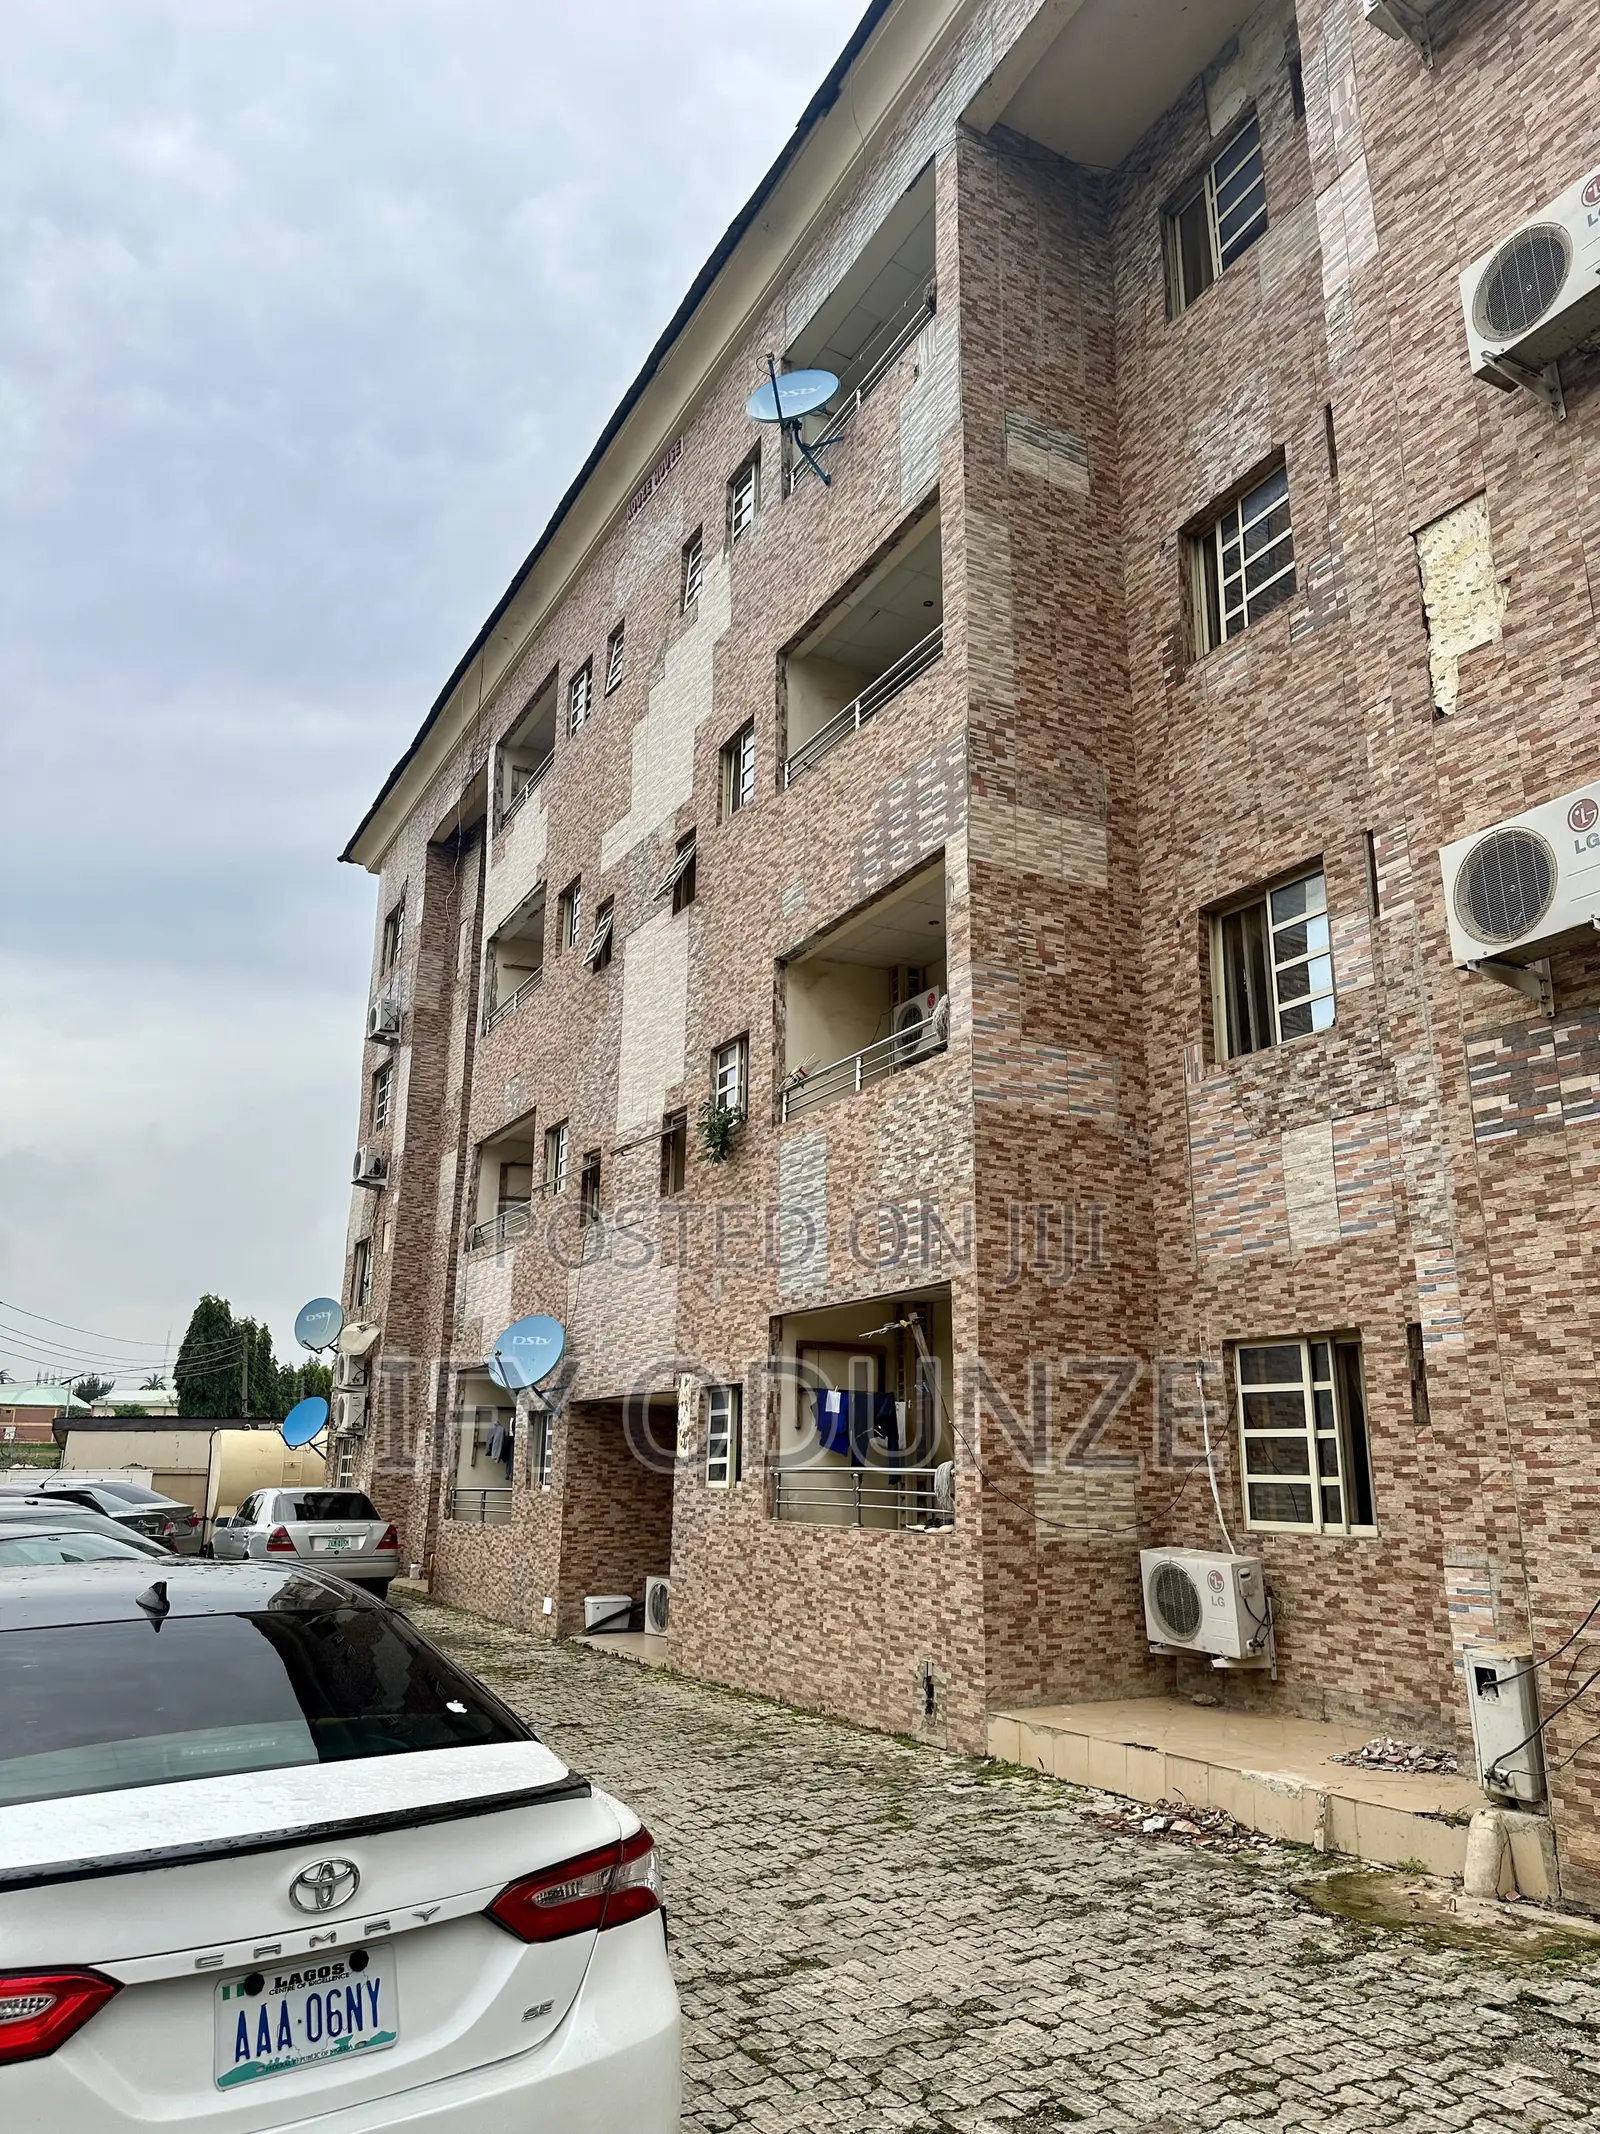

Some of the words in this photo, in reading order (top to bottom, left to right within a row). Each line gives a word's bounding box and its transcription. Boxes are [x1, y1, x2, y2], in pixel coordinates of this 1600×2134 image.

[1587, 208, 1600, 228] L
[653, 438, 682, 486] HOUSE
[1574, 832, 1600, 855] LG
[512, 1335, 553, 1346] DStv
[1211, 1595, 1226, 1608] LG
[195, 1905, 441, 1969] CAMRY
[268, 1984, 296, 1996] CENTRE
[296, 1982, 307, 1990] OF
[308, 1971, 350, 1987] EXCELLENCE
[274, 1962, 345, 1989] LAGOS
[521, 1998, 555, 2023] SE
